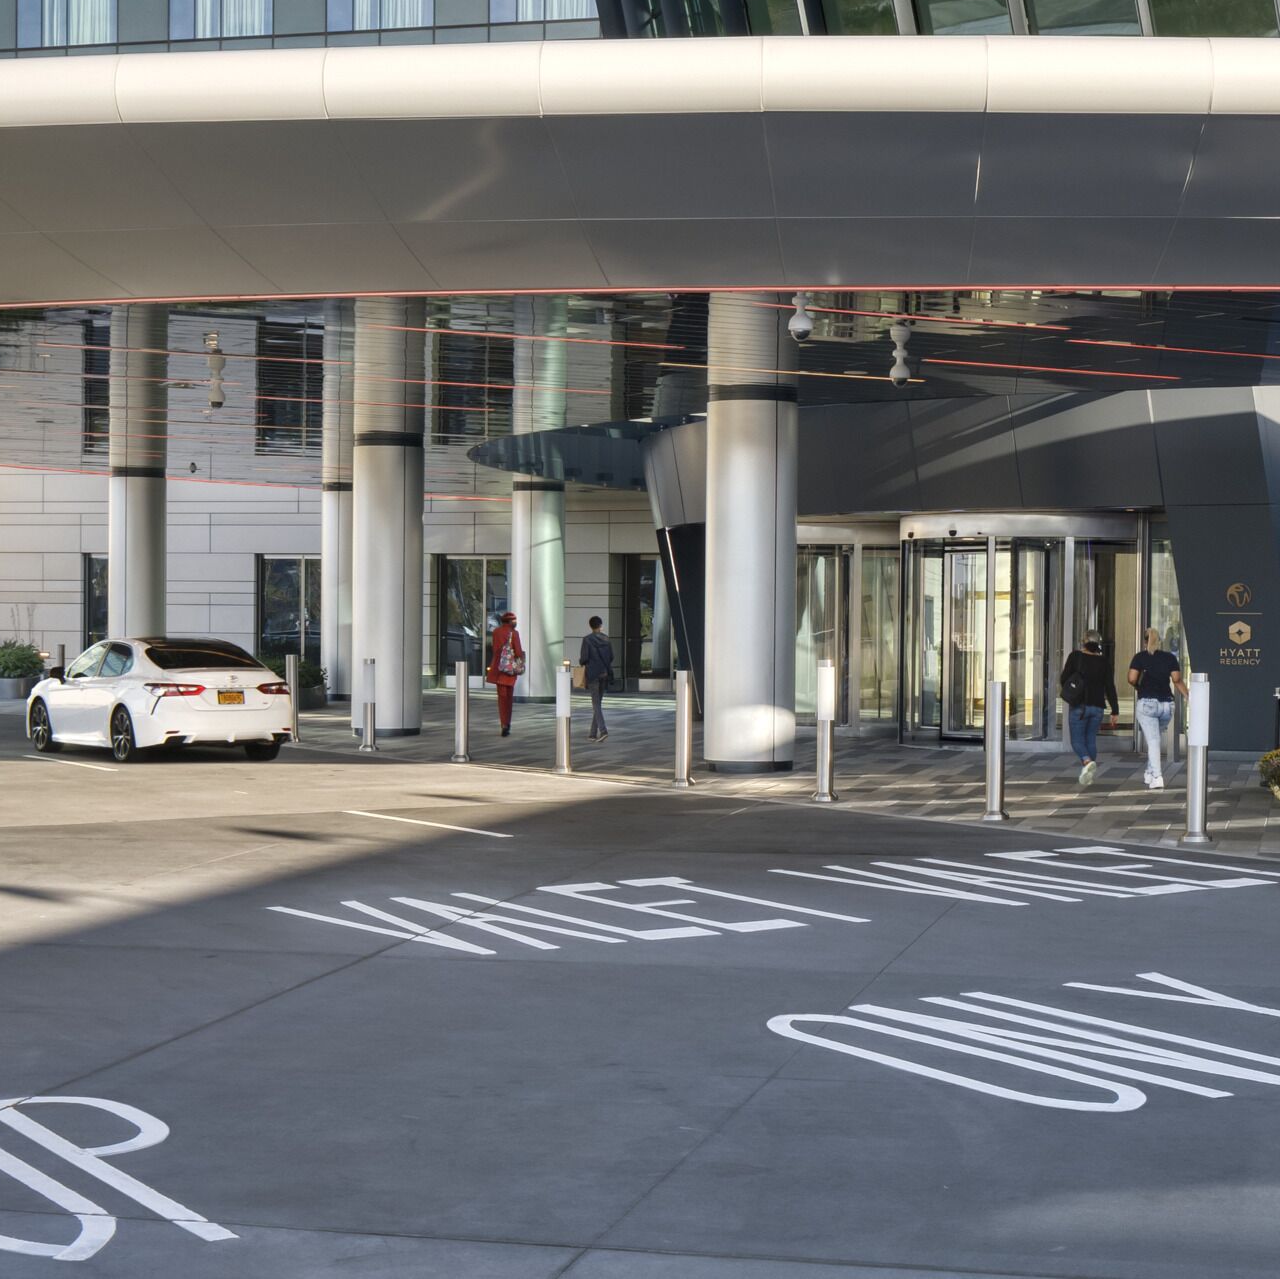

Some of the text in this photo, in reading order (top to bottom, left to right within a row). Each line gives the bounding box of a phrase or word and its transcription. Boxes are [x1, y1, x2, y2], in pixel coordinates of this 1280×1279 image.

[1220, 648, 1261, 657] HYATT
[1219, 658, 1261, 666] REGENCY
[266, 876, 872, 956] VALET
